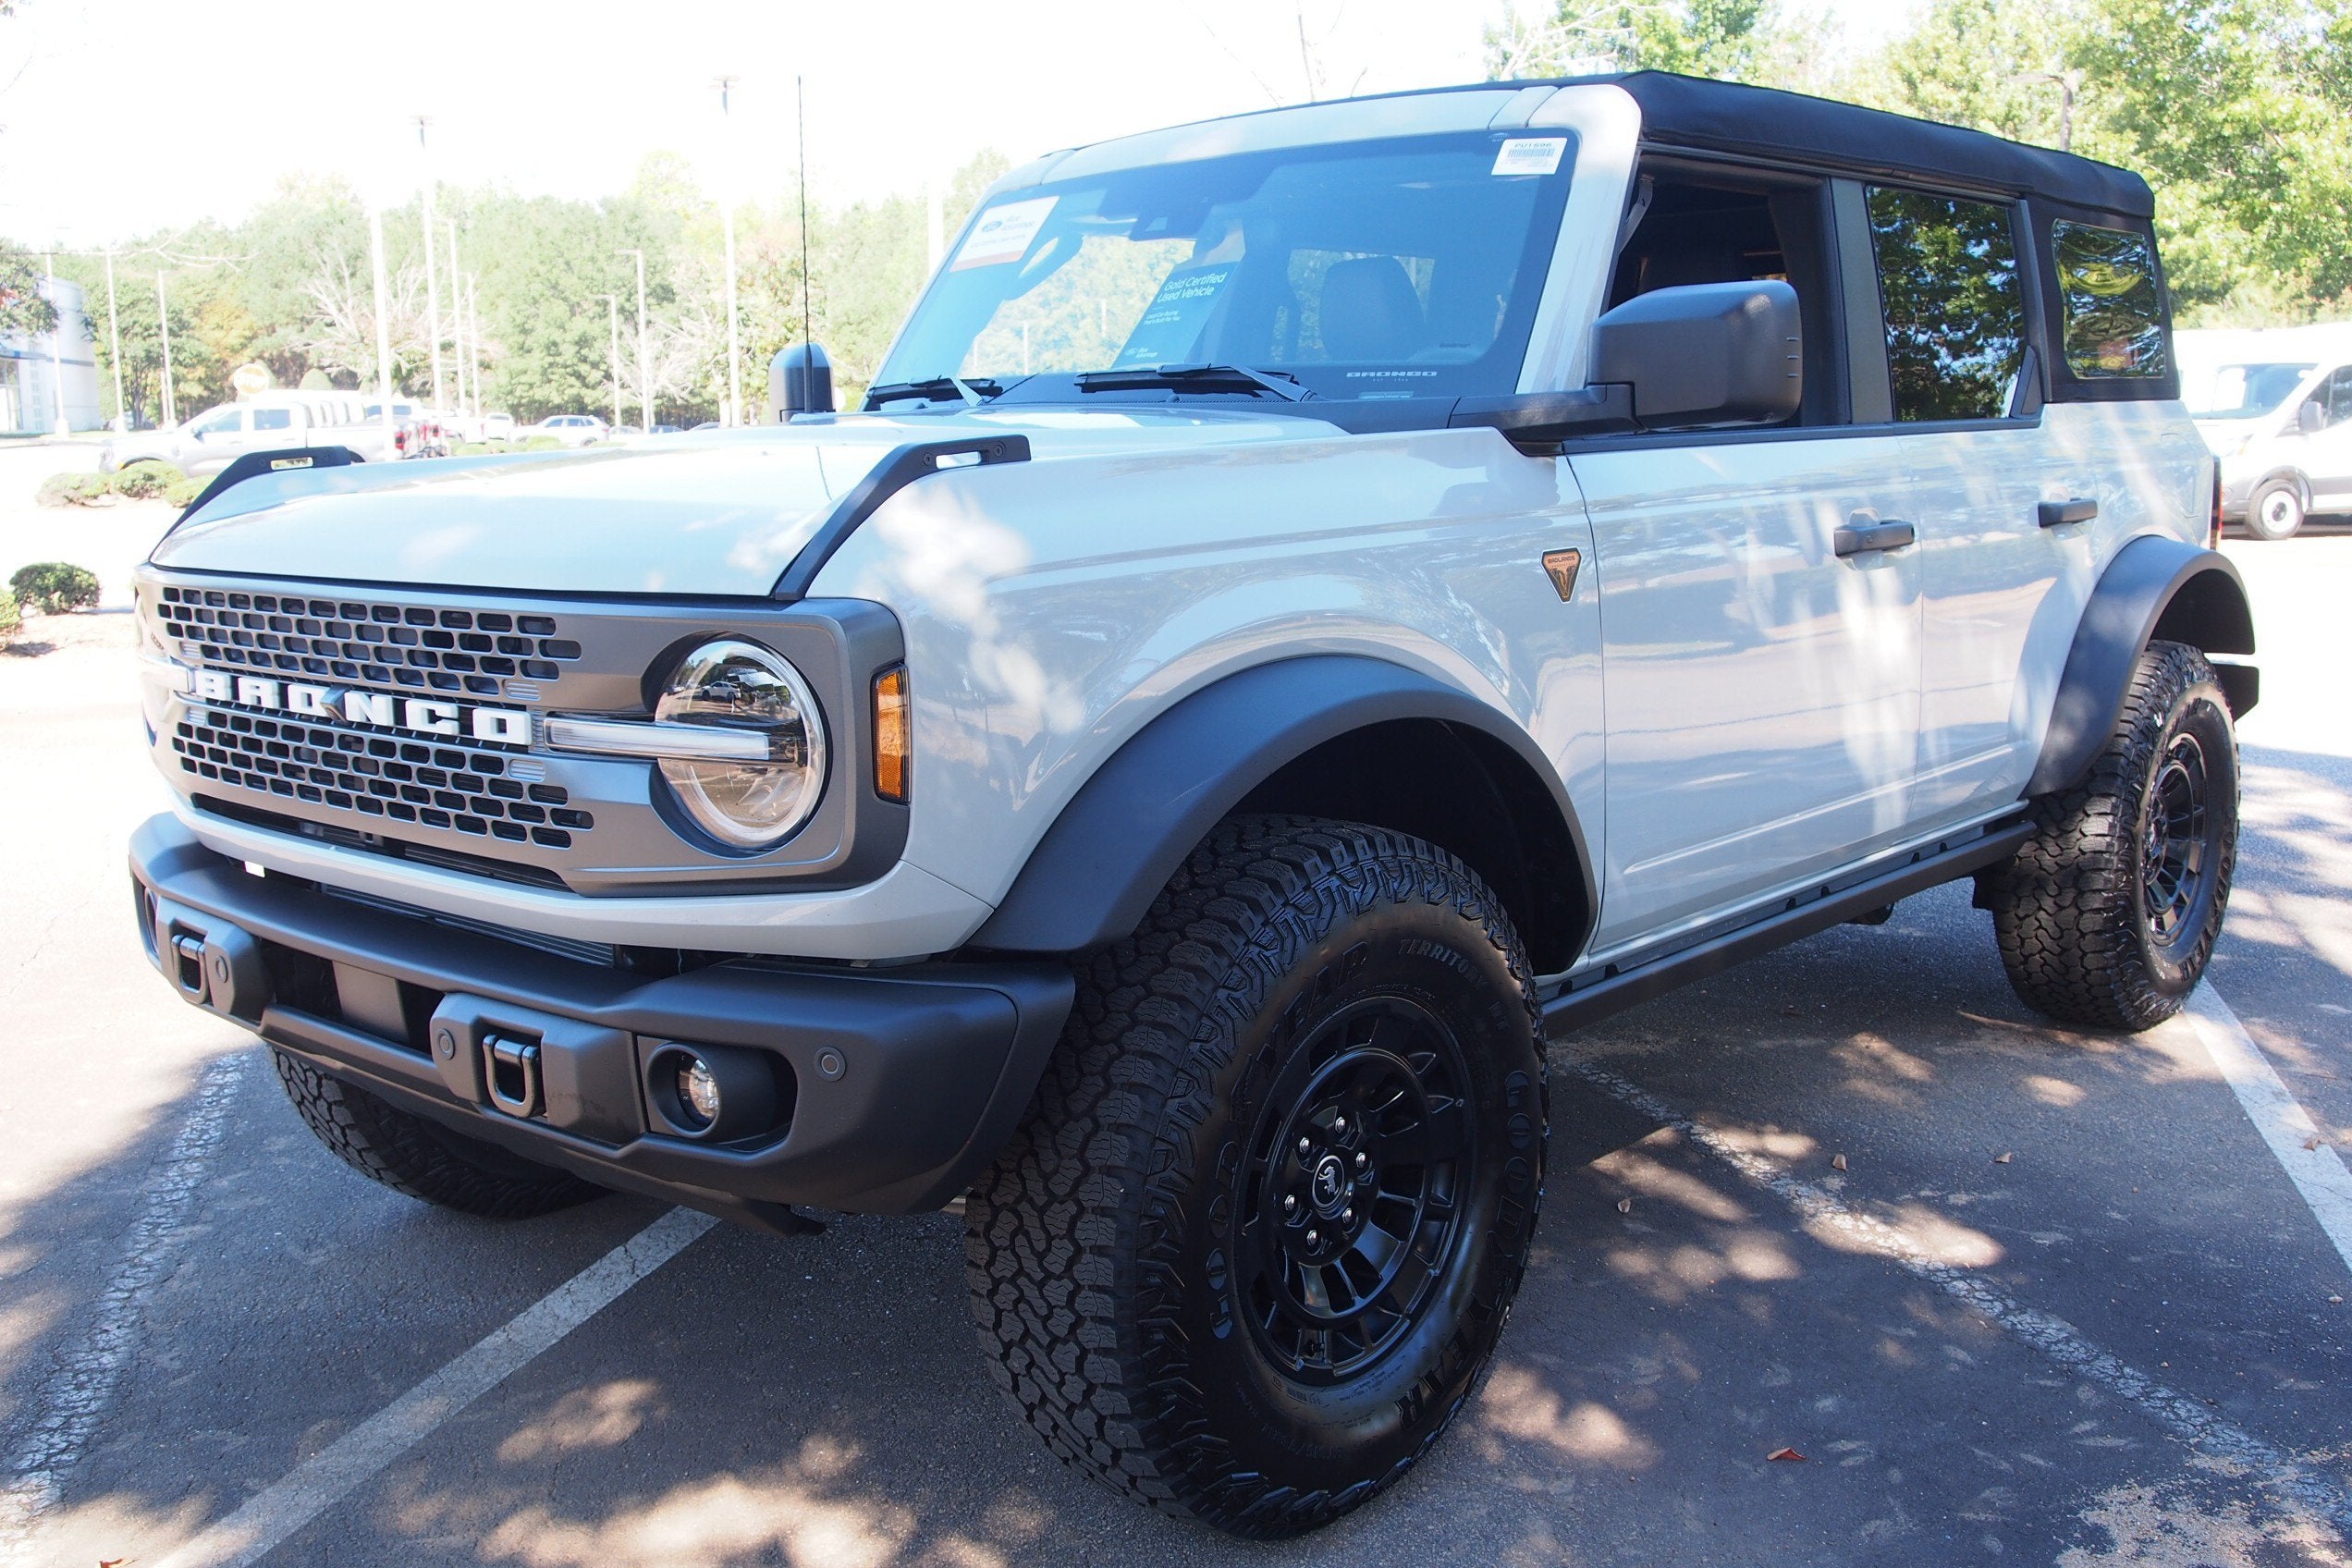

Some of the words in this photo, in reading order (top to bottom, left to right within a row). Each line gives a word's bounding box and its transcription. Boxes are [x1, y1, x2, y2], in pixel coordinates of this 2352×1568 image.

[1164, 278, 1186, 291] Gold
[1185, 271, 1228, 288] Certified
[1157, 288, 1182, 303] Used
[1182, 285, 1215, 299] Vehicle
[1547, 555, 1575, 564] BADLANDS
[194, 669, 533, 745] BRONCO
[1398, 938, 1487, 986] TERRITORY
